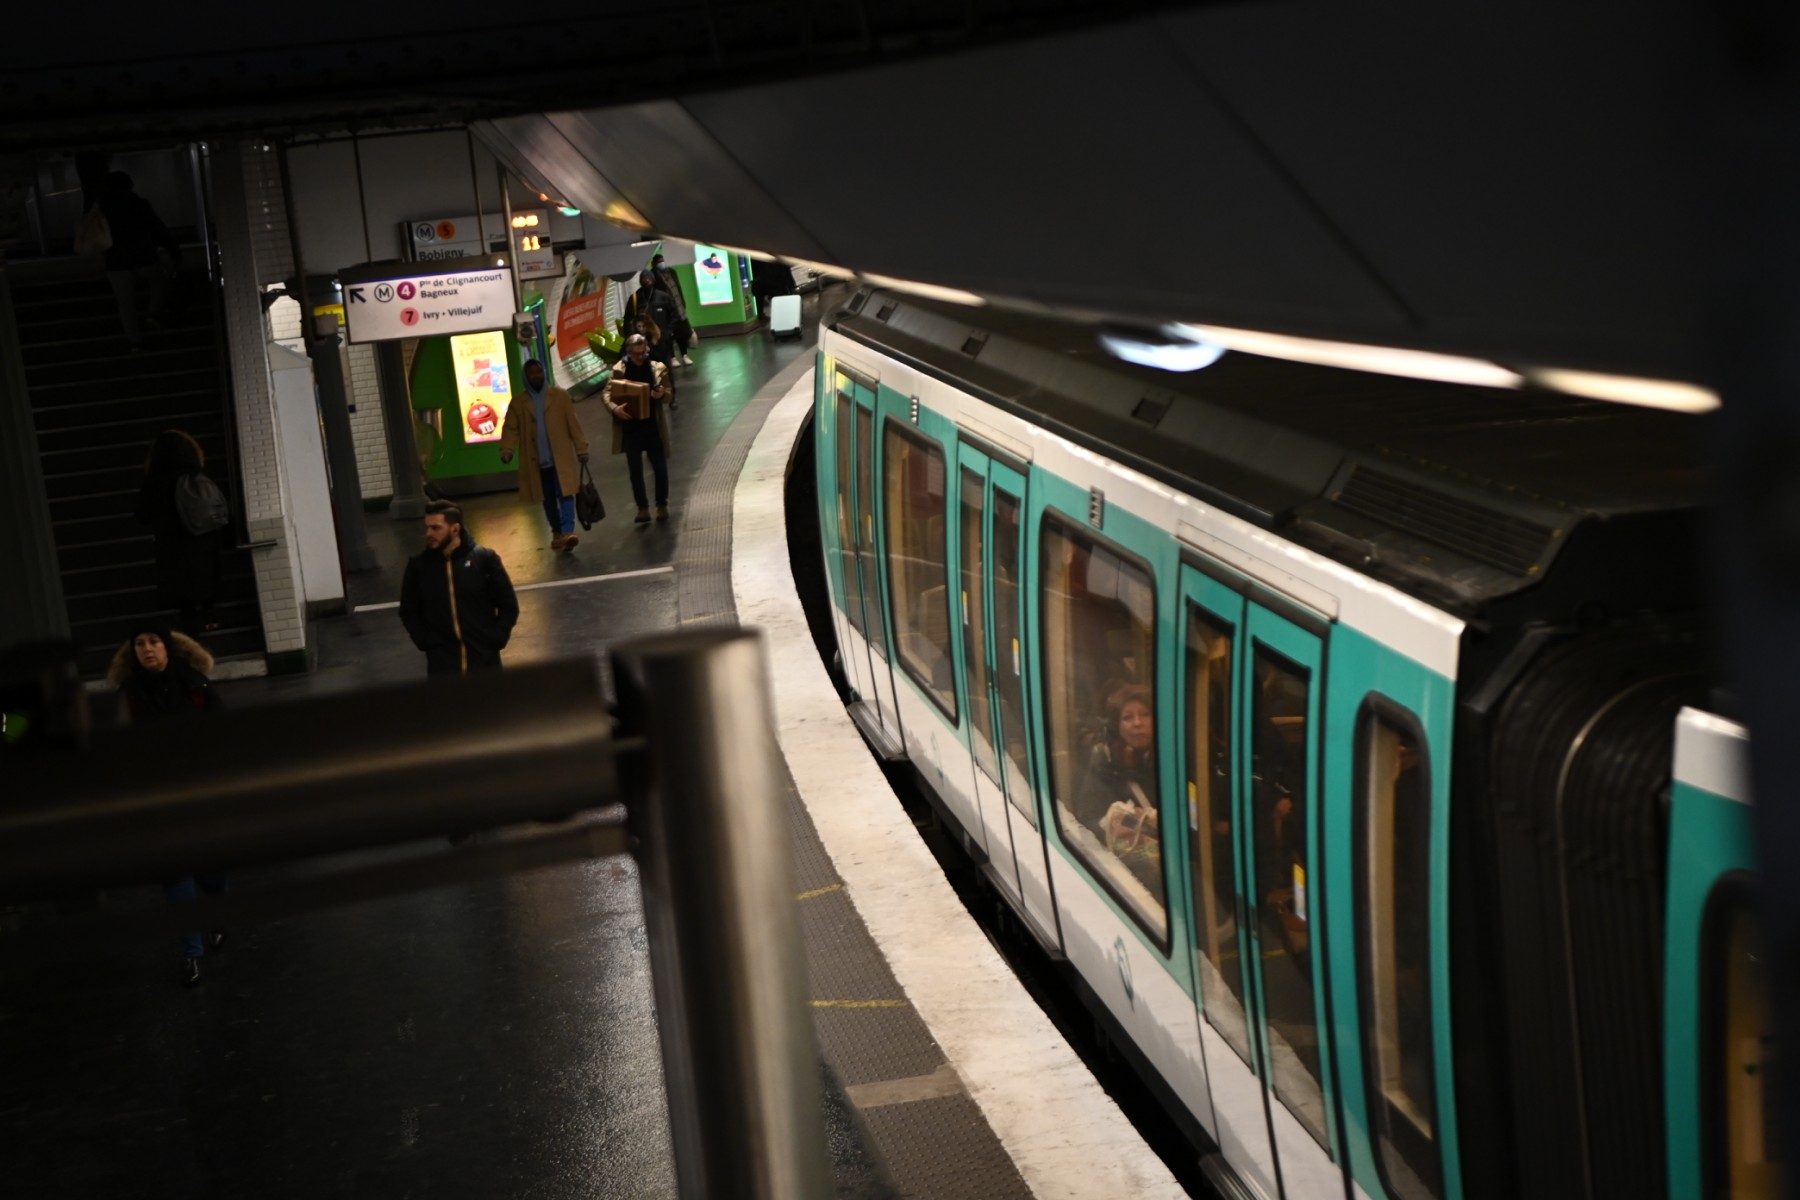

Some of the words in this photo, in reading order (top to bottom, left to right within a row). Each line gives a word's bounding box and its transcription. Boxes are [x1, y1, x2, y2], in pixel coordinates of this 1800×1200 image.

[419, 249, 465, 261] Bobigny
[433, 278, 443, 286] de
[446, 273, 503, 286] Clignancourt
[420, 288, 458, 299] Bagneux
[423, 310, 440, 320] Ivry
[447, 305, 483, 317] Villejuif
